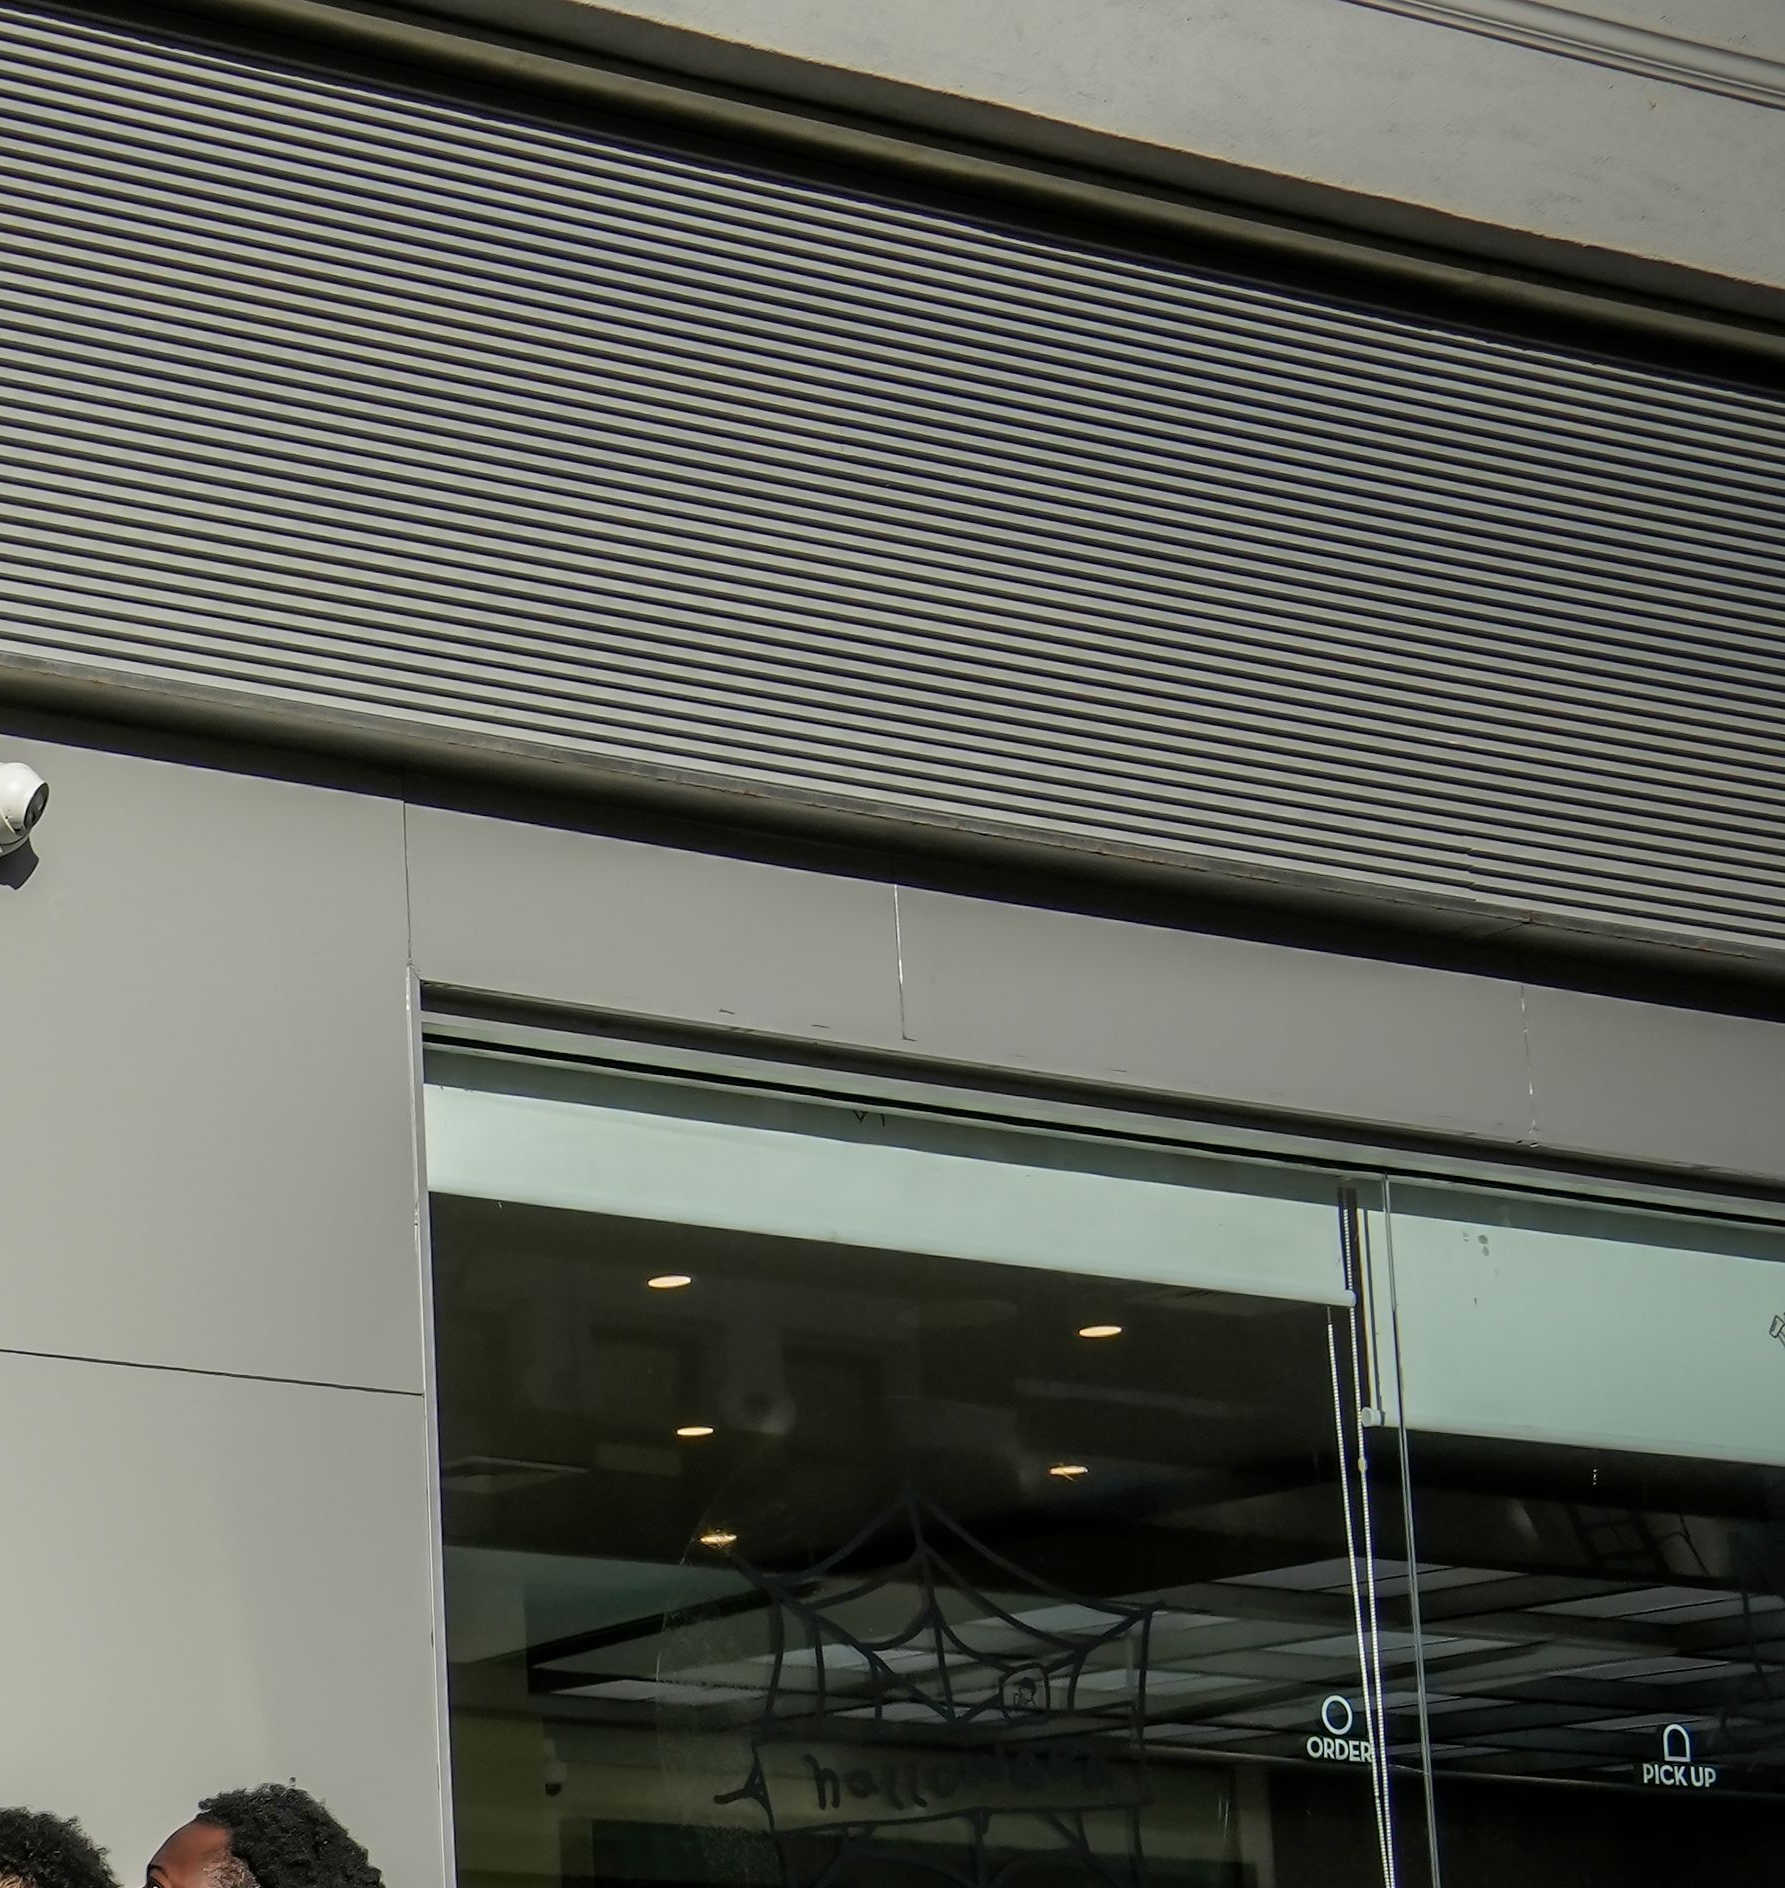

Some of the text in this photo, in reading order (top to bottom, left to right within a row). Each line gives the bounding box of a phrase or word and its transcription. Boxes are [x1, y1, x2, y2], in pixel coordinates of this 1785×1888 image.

[1307, 1736, 1374, 1763] ORDER
[1642, 1763, 1717, 1787] PICK UP
